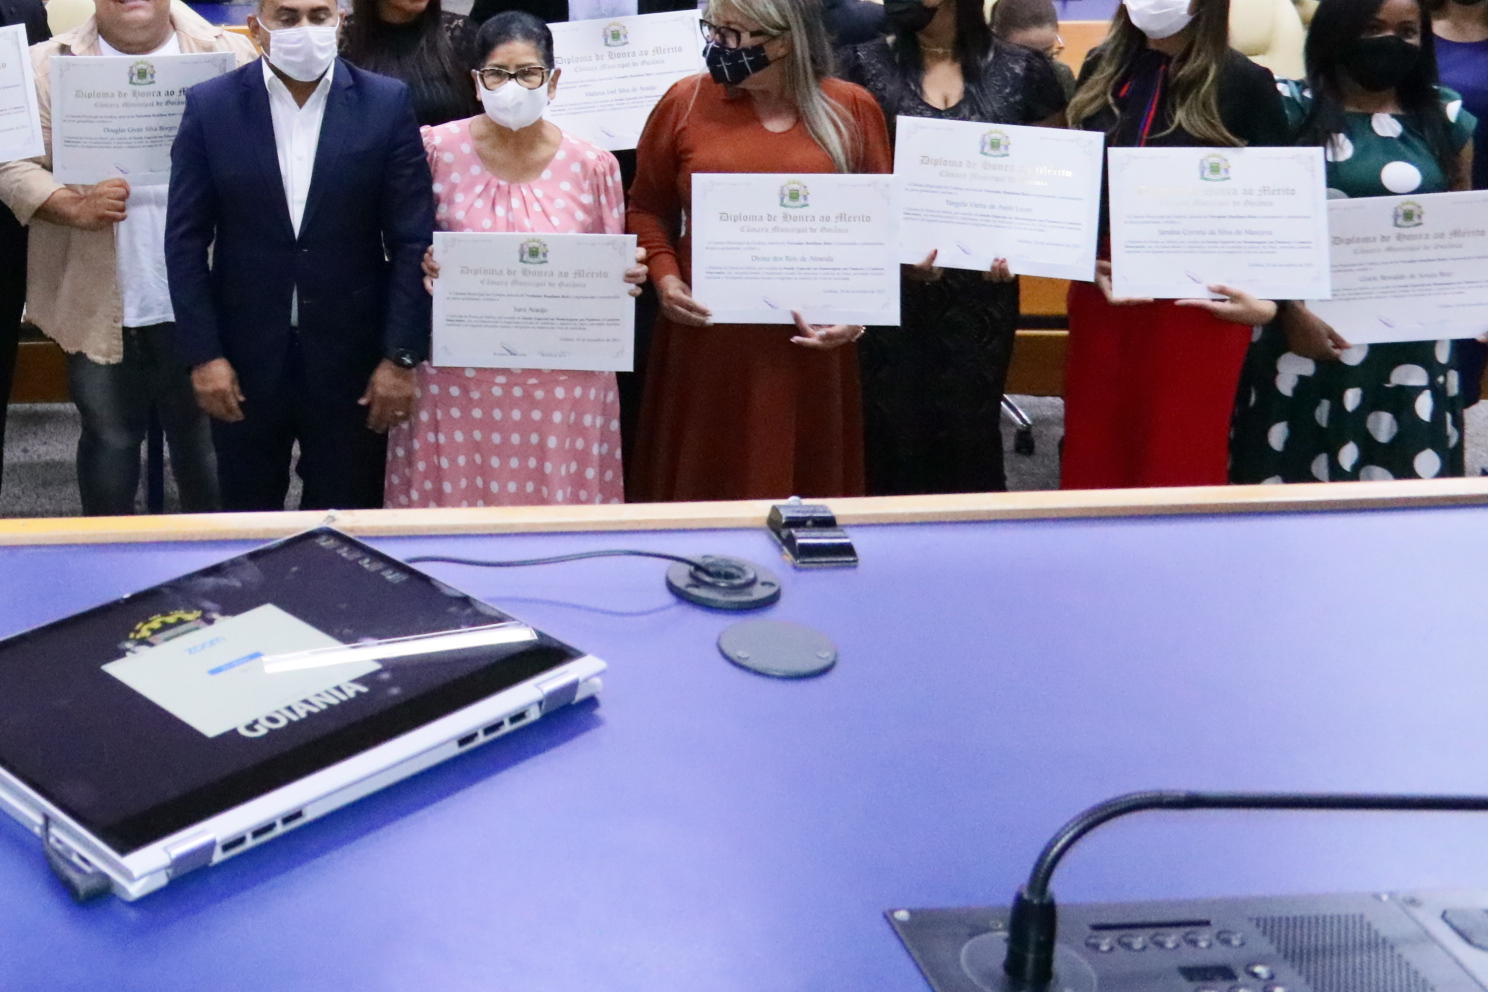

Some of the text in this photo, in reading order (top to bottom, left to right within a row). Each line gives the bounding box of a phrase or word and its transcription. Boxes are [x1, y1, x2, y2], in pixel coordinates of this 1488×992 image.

[556, 55, 592, 65] Diploma
[608, 50, 636, 60] Honra
[75, 90, 115, 99] Diploma
[132, 90, 161, 99] Honra
[719, 212, 763, 223] Diploma
[783, 213, 816, 223] Honra
[460, 267, 503, 276] Diploma
[522, 268, 554, 278] Honra
[184, 636, 227, 655] zoom
